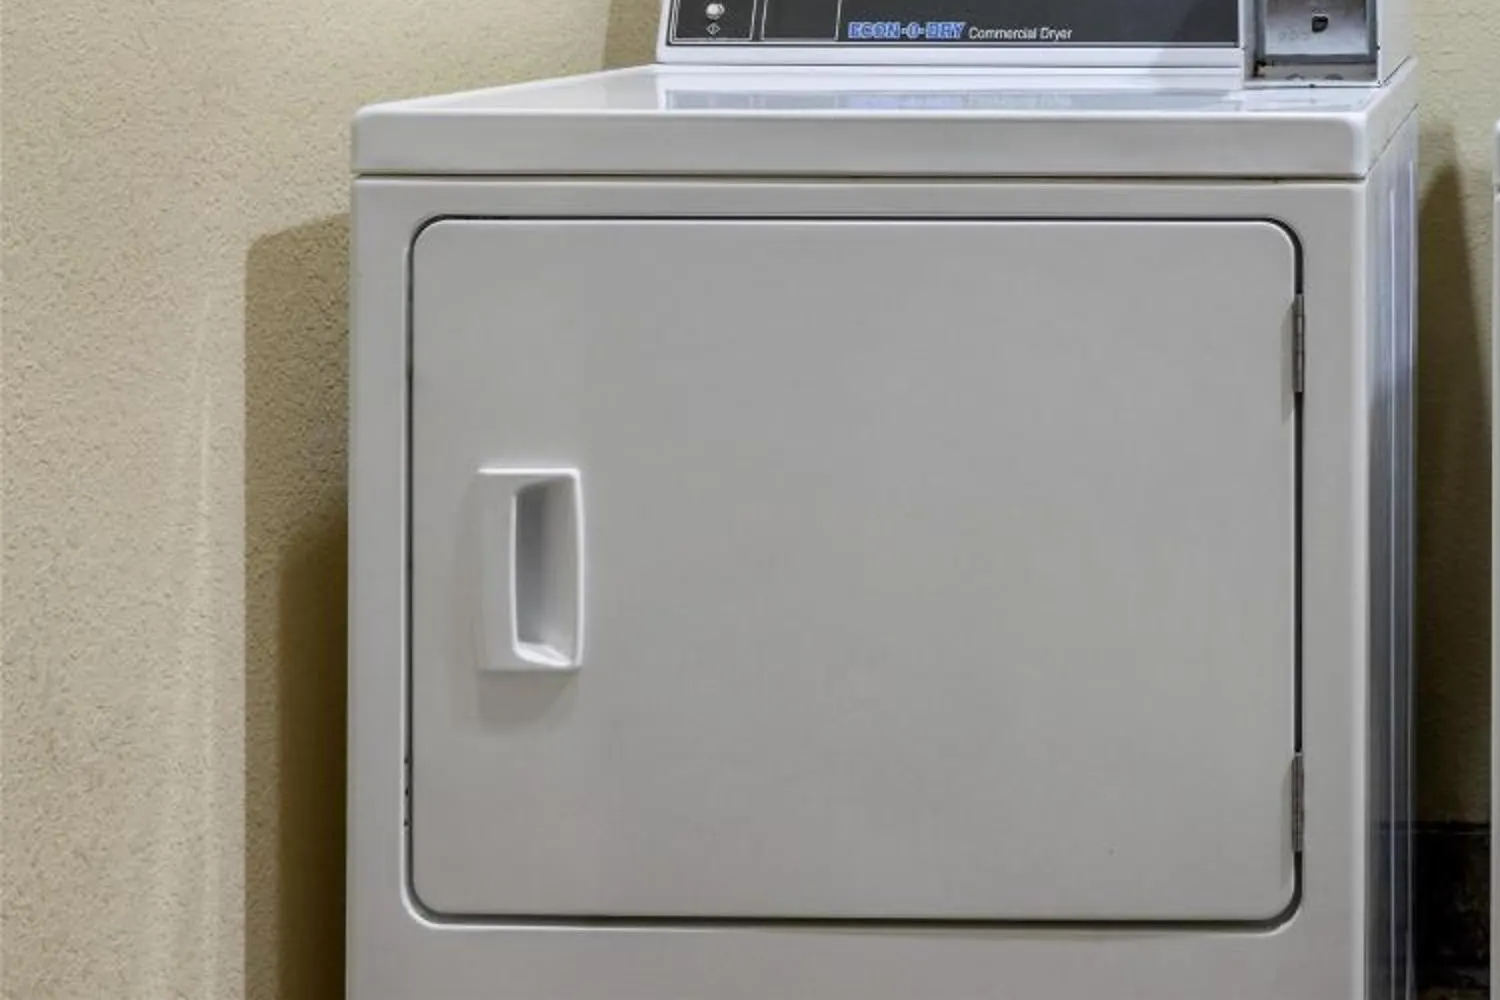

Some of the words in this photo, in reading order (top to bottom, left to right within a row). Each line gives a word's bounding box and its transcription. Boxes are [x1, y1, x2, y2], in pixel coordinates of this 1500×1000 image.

[848, 21, 966, 38] ECON-O-DRY
[968, 26, 1037, 40] Commercial
[1039, 27, 1073, 43] Dryer
